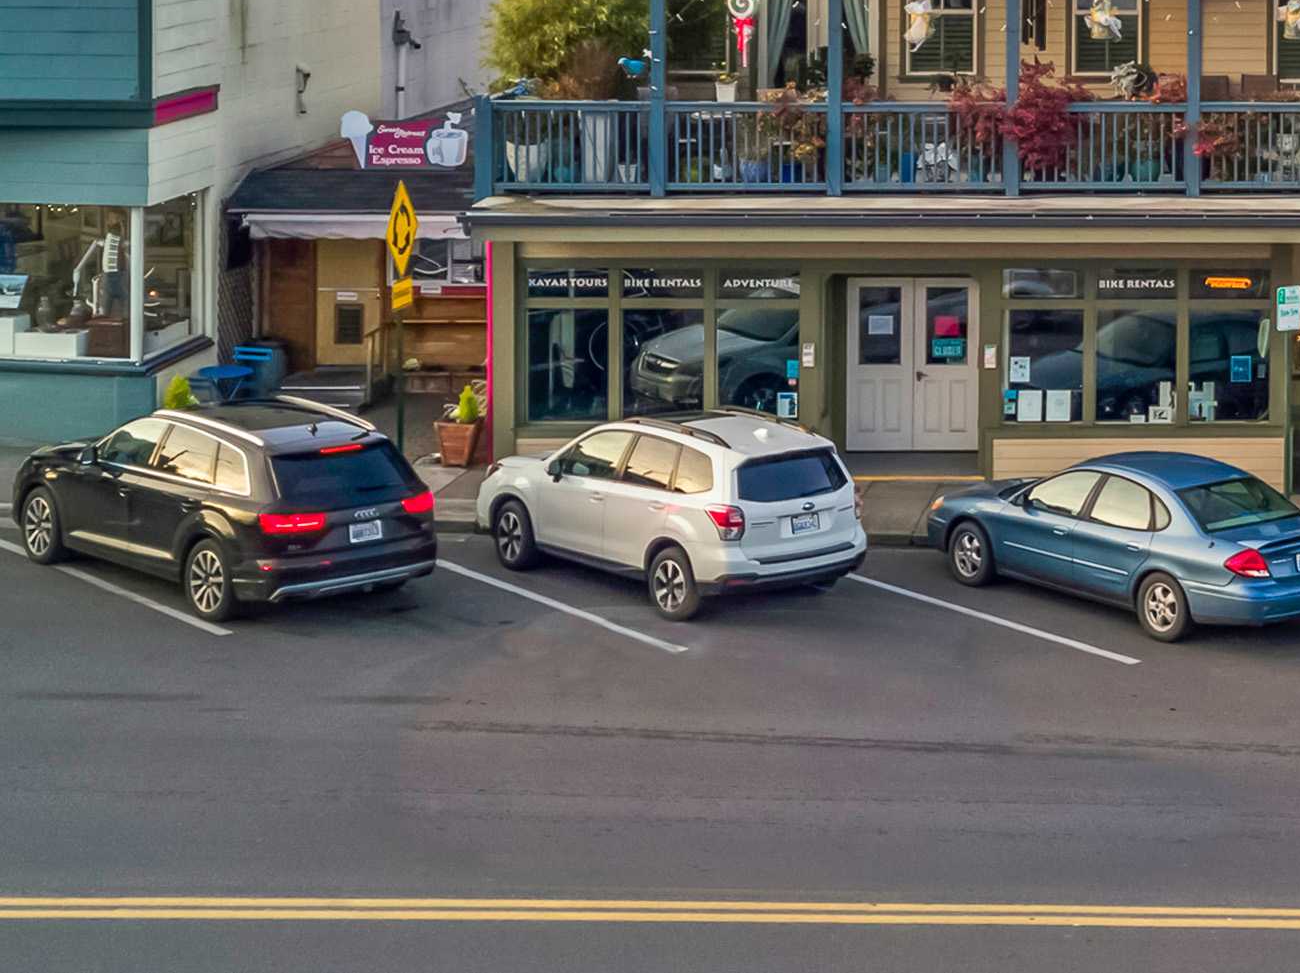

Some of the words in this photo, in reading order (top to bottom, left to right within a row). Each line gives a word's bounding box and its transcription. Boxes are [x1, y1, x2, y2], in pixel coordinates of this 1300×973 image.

[368, 145, 385, 155] Ice
[388, 144, 424, 155] Cream
[372, 155, 422, 166] Espresso
[528, 278, 568, 287] KAYAK
[568, 278, 608, 287] TOURS
[623, 278, 649, 288] BIKE
[652, 278, 702, 288] RENTALS
[723, 278, 794, 288] ADVENTURE
[1098, 279, 1125, 289] BIKE
[1126, 279, 1175, 289] RENTALS
